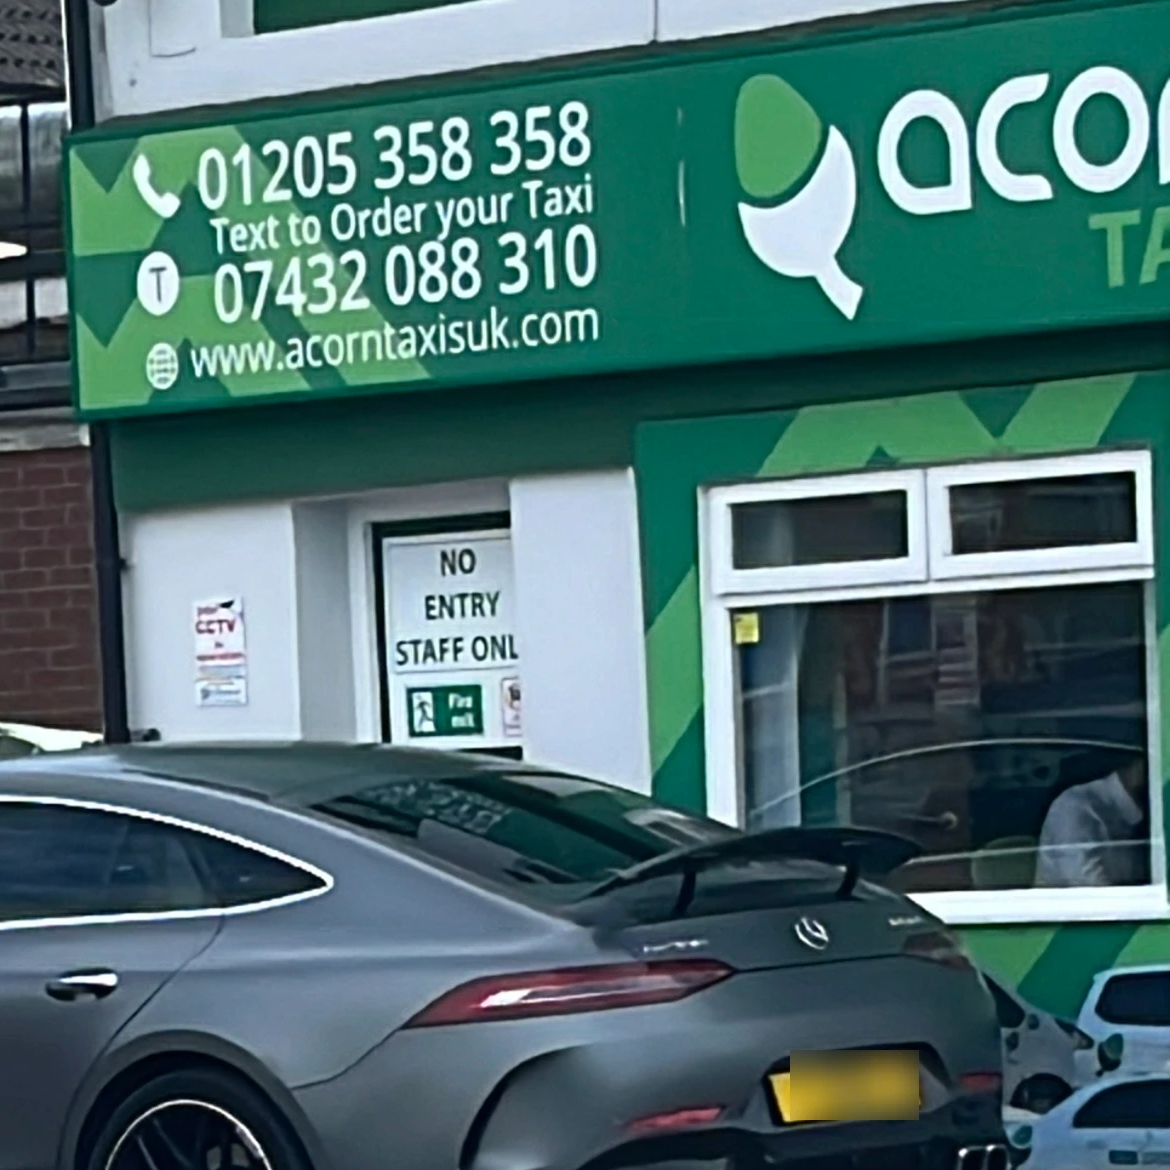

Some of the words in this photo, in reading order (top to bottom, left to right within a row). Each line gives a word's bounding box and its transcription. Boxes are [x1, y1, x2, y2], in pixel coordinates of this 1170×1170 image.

[198, 131, 357, 211] 01205
[373, 117, 473, 189] 358
[489, 101, 592, 176] 358
[878, 65, 1170, 216] aco
[209, 212, 280, 255] Text
[287, 211, 322, 246] to
[331, 196, 428, 242] Order
[434, 192, 514, 242] your
[522, 173, 594, 220] Taxi
[148, 265, 168, 303] T
[214, 249, 371, 324] 07432
[385, 237, 483, 307] 088
[497, 224, 598, 295] 310
[190, 306, 600, 379] www.acorntaxisuk.com
[440, 548, 477, 577] NO
[195, 618, 236, 635] CCTV
[425, 590, 501, 621] ENTRY
[395, 636, 465, 667] STAFF
